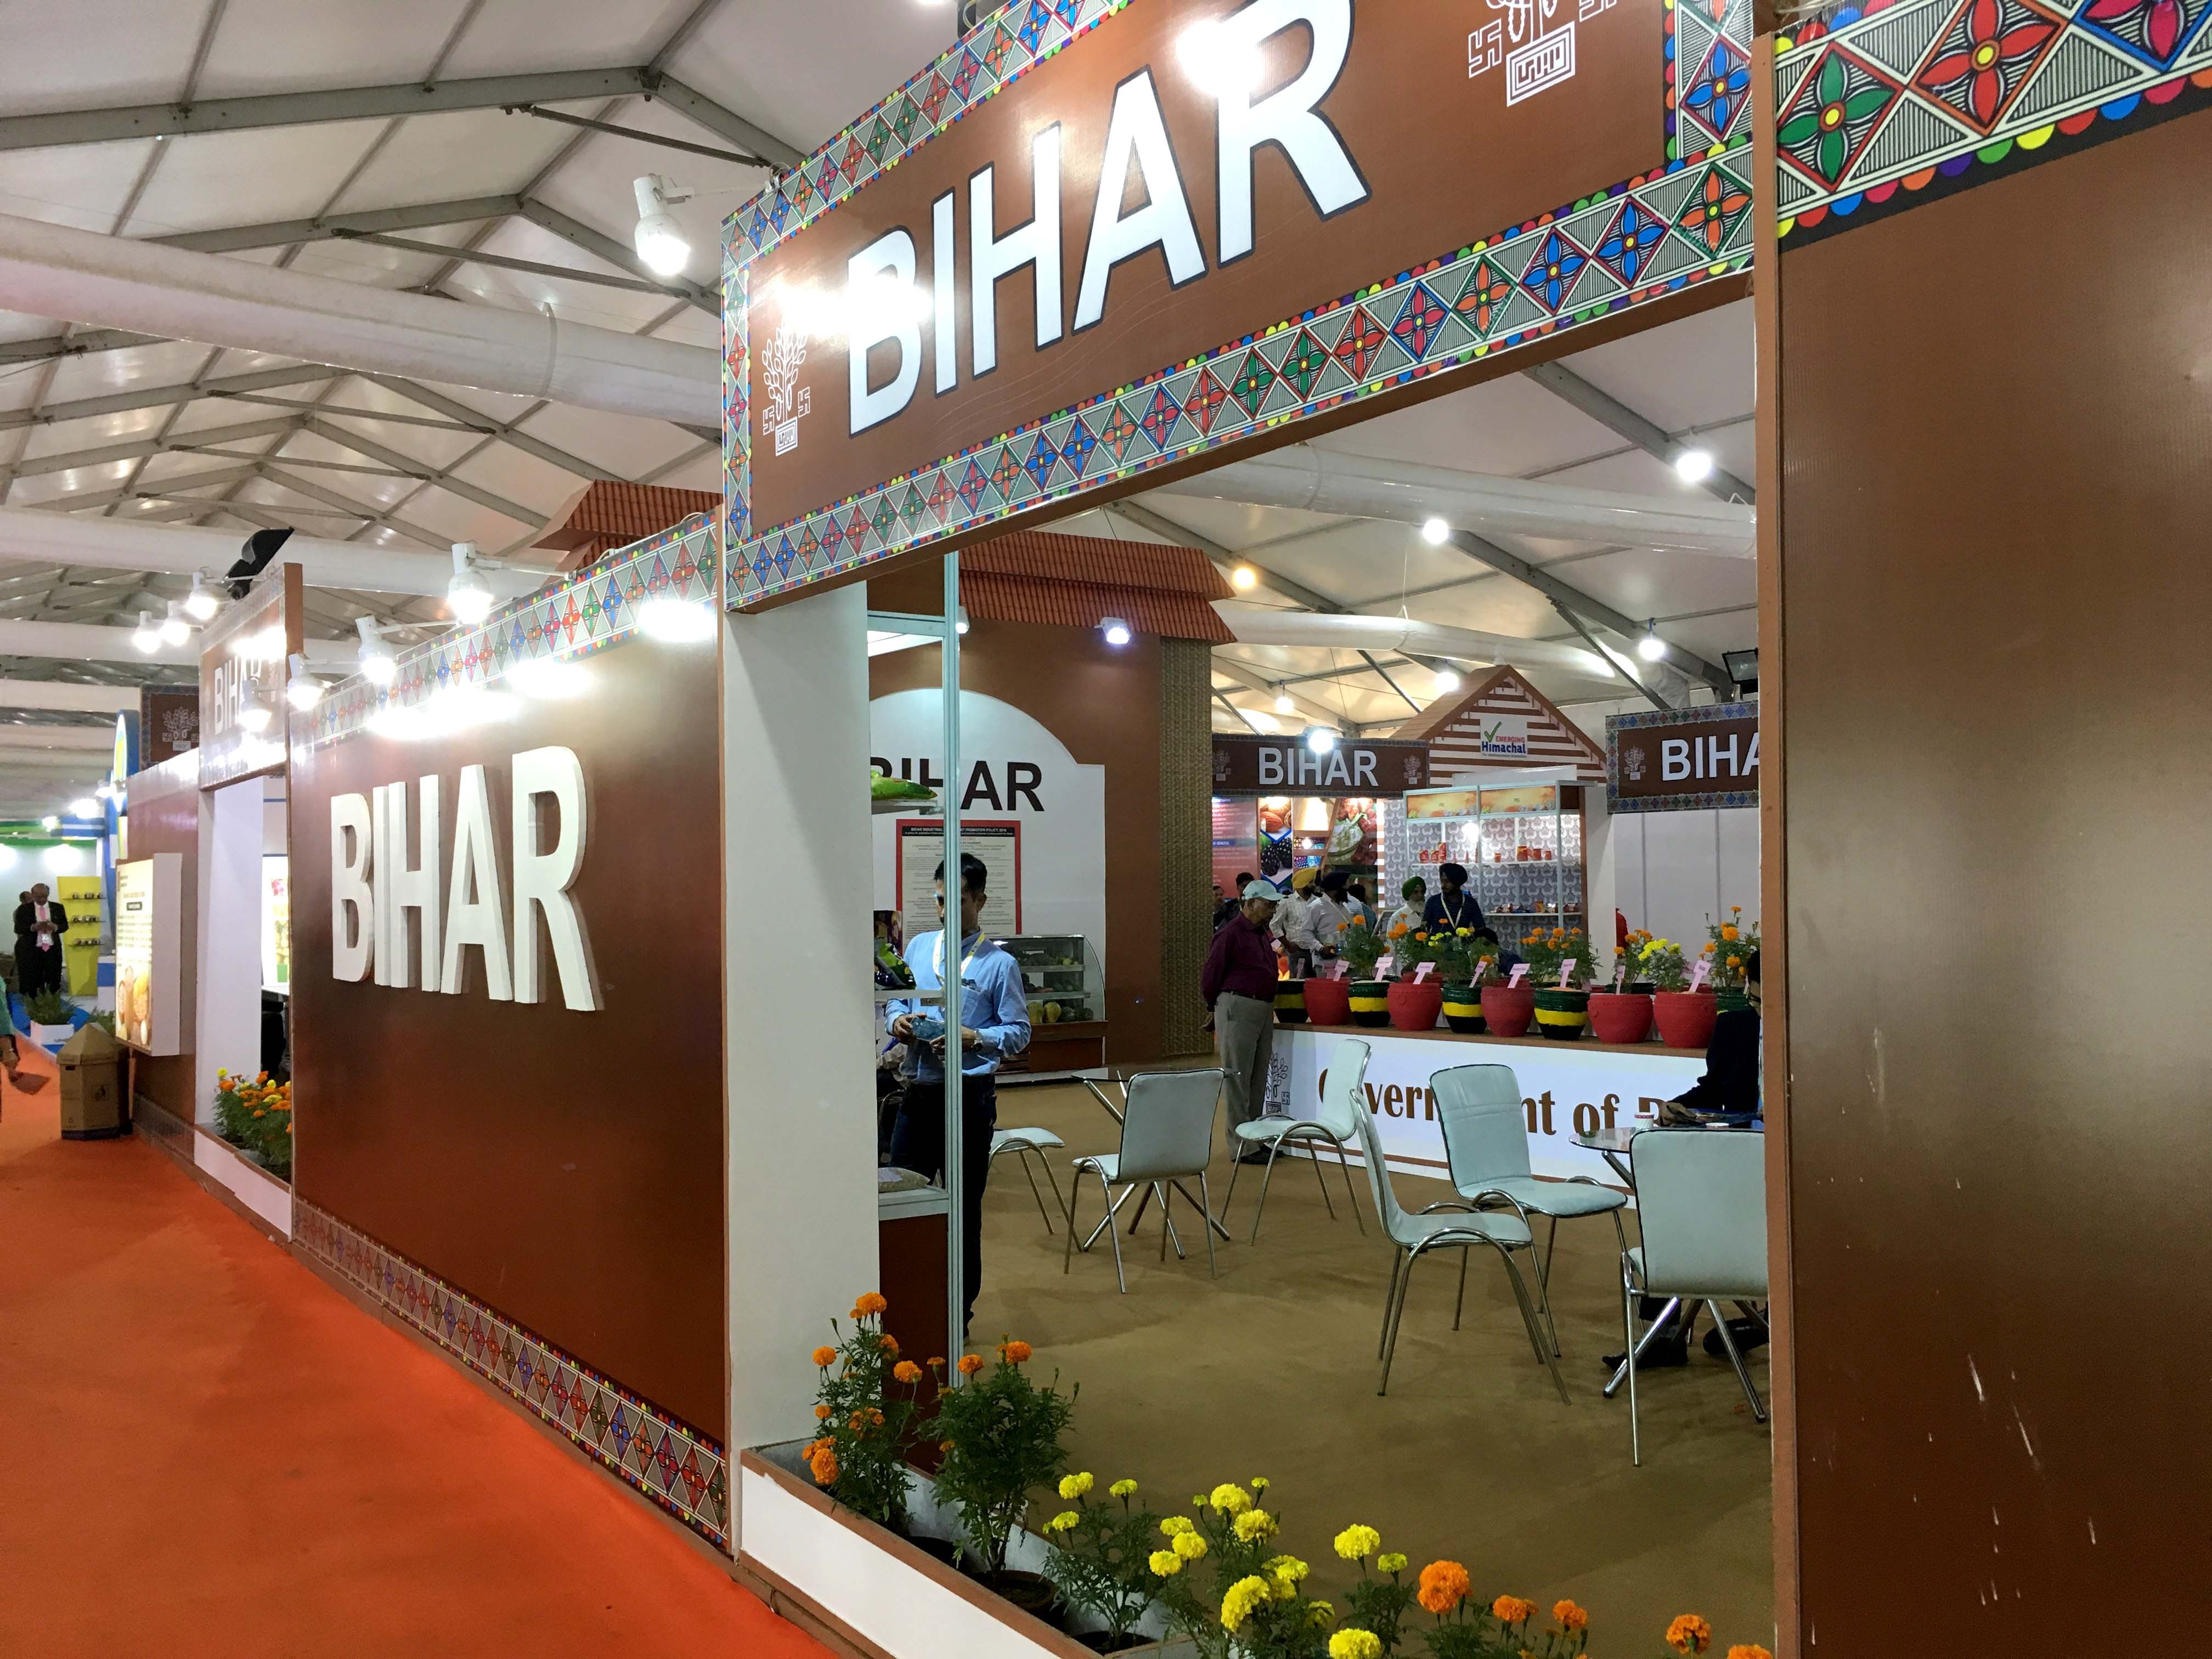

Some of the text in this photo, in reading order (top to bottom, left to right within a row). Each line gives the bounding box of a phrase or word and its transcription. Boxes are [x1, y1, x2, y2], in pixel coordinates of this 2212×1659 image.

[848, 0, 1372, 438] BIHAR
[1259, 746, 1379, 787] BIHAR
[1482, 741, 1526, 754] Himachal
[331, 745, 596, 1012] BIHAR
[1573, 1093, 1620, 1140] of
